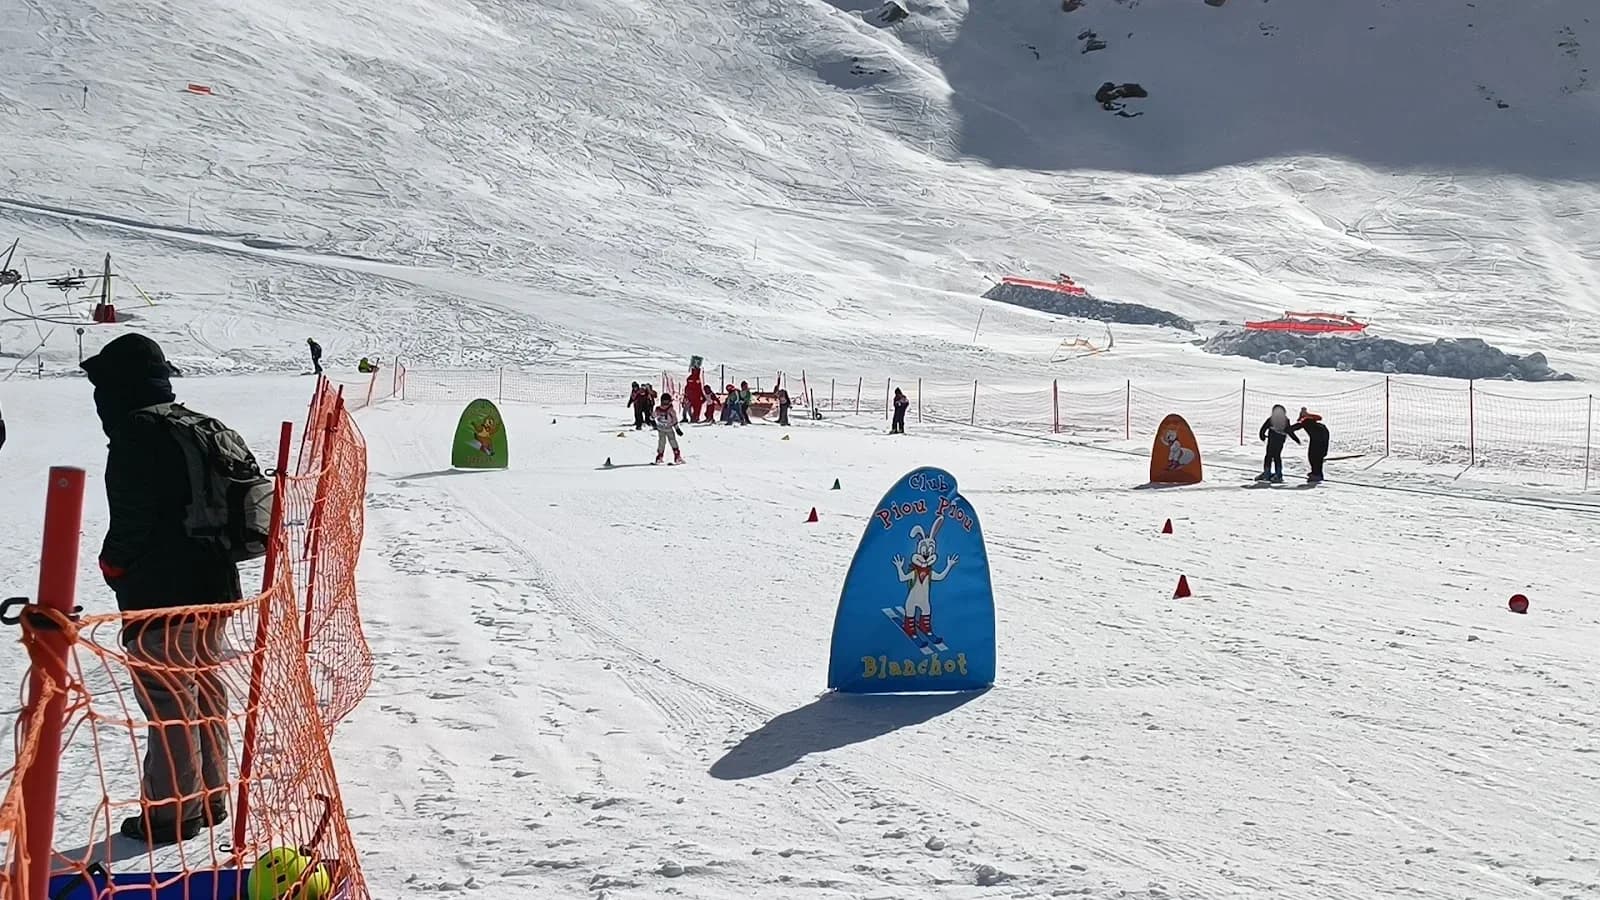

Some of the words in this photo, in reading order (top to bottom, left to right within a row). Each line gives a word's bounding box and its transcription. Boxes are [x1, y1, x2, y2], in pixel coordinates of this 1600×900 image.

[909, 473, 949, 491] Club
[875, 499, 928, 530] Piou
[936, 495, 973, 532] Piou
[861, 652, 968, 679] Blanchot
